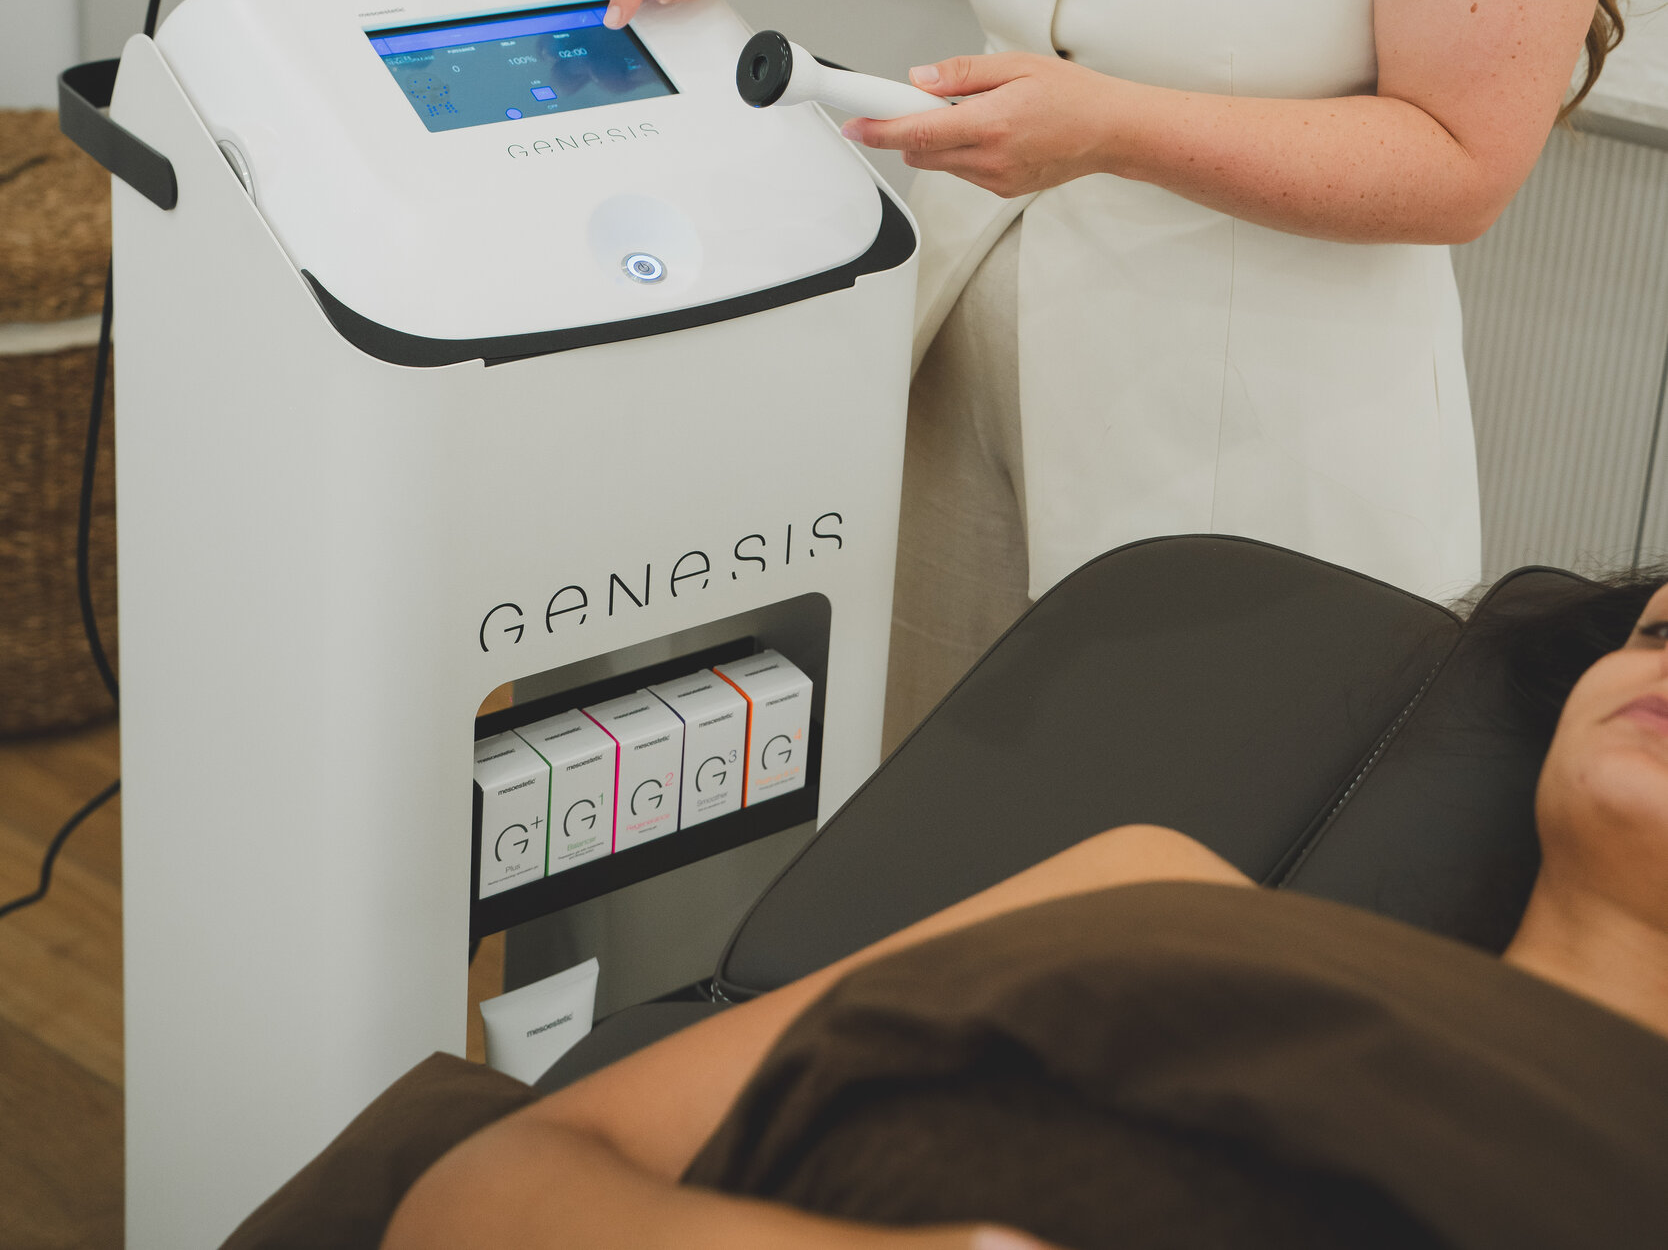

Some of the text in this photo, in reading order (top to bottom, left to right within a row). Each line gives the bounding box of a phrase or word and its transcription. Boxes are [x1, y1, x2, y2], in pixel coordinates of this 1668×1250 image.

[508, 55, 537, 66] 100%
[558, 47, 588, 58] 02:00
[634, 734, 671, 751] mesoestetic
[566, 754, 603, 771] mesoestetic
[497, 778, 536, 796] mesoestetic
[505, 863, 521, 873] Plus
[526, 1012, 574, 1038] mesoestetic
